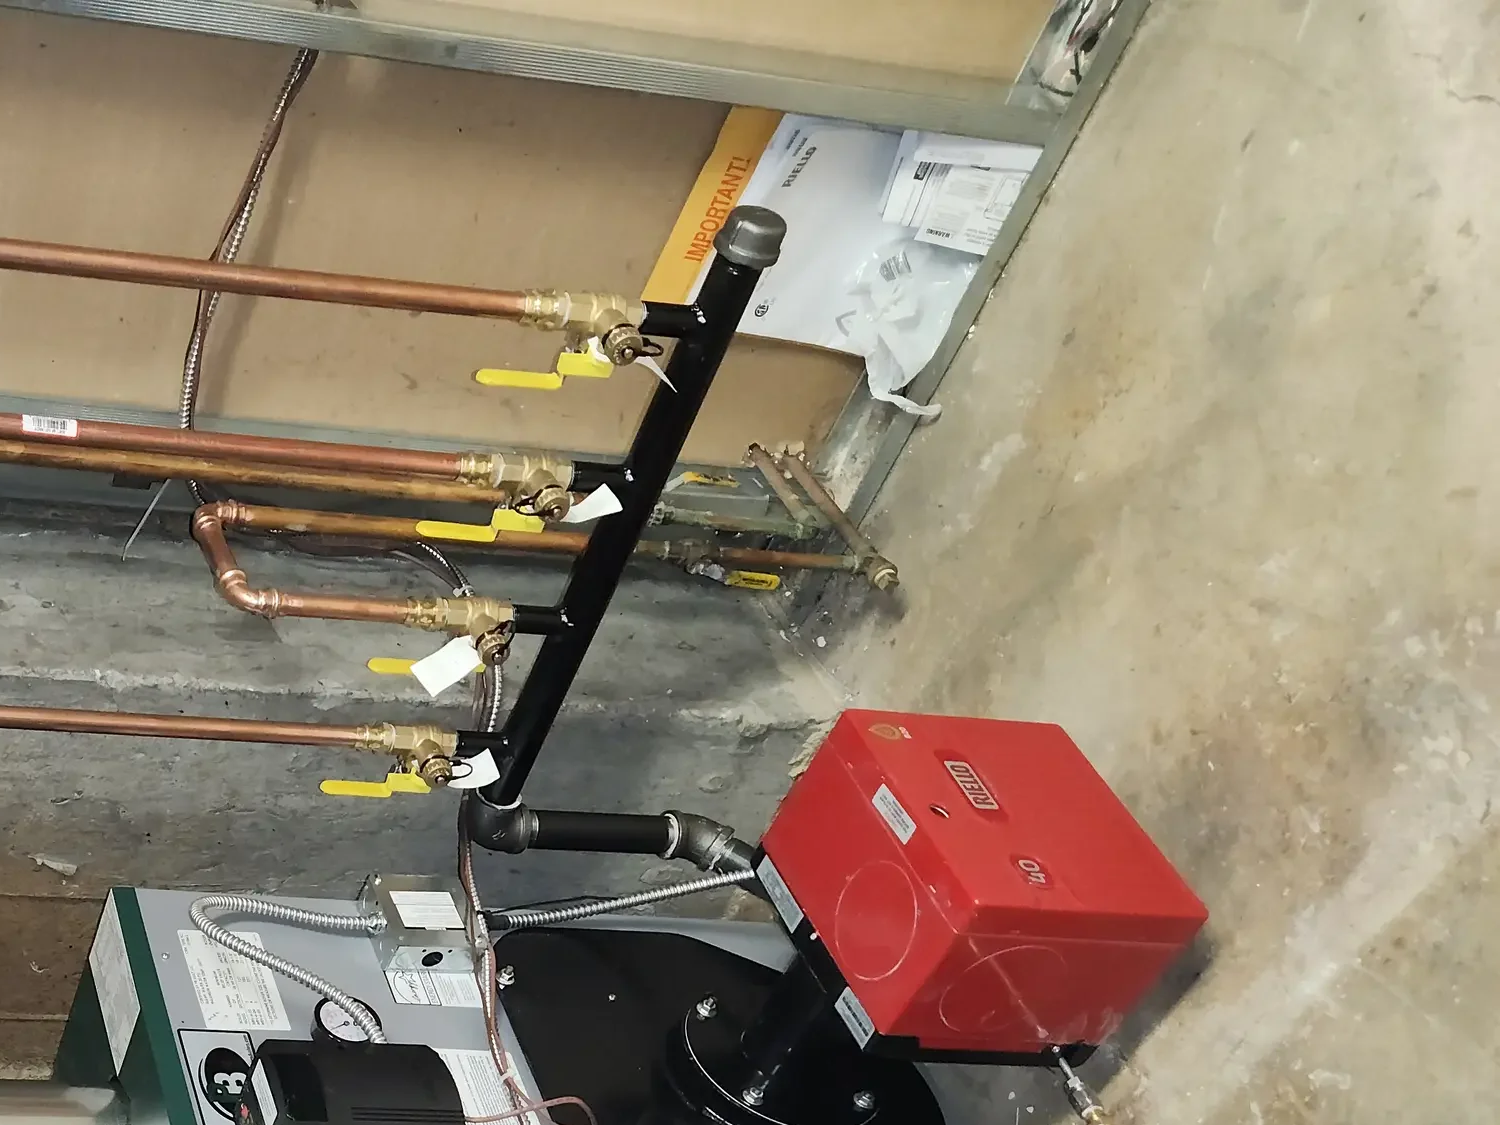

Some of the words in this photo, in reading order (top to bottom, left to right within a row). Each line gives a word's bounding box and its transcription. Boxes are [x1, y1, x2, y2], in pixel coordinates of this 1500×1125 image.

[781, 146, 818, 188] RIELLO
[684, 156, 753, 263] IMPORTANT!
[949, 765, 994, 806] RIELLO
[1018, 860, 1045, 883] 40
